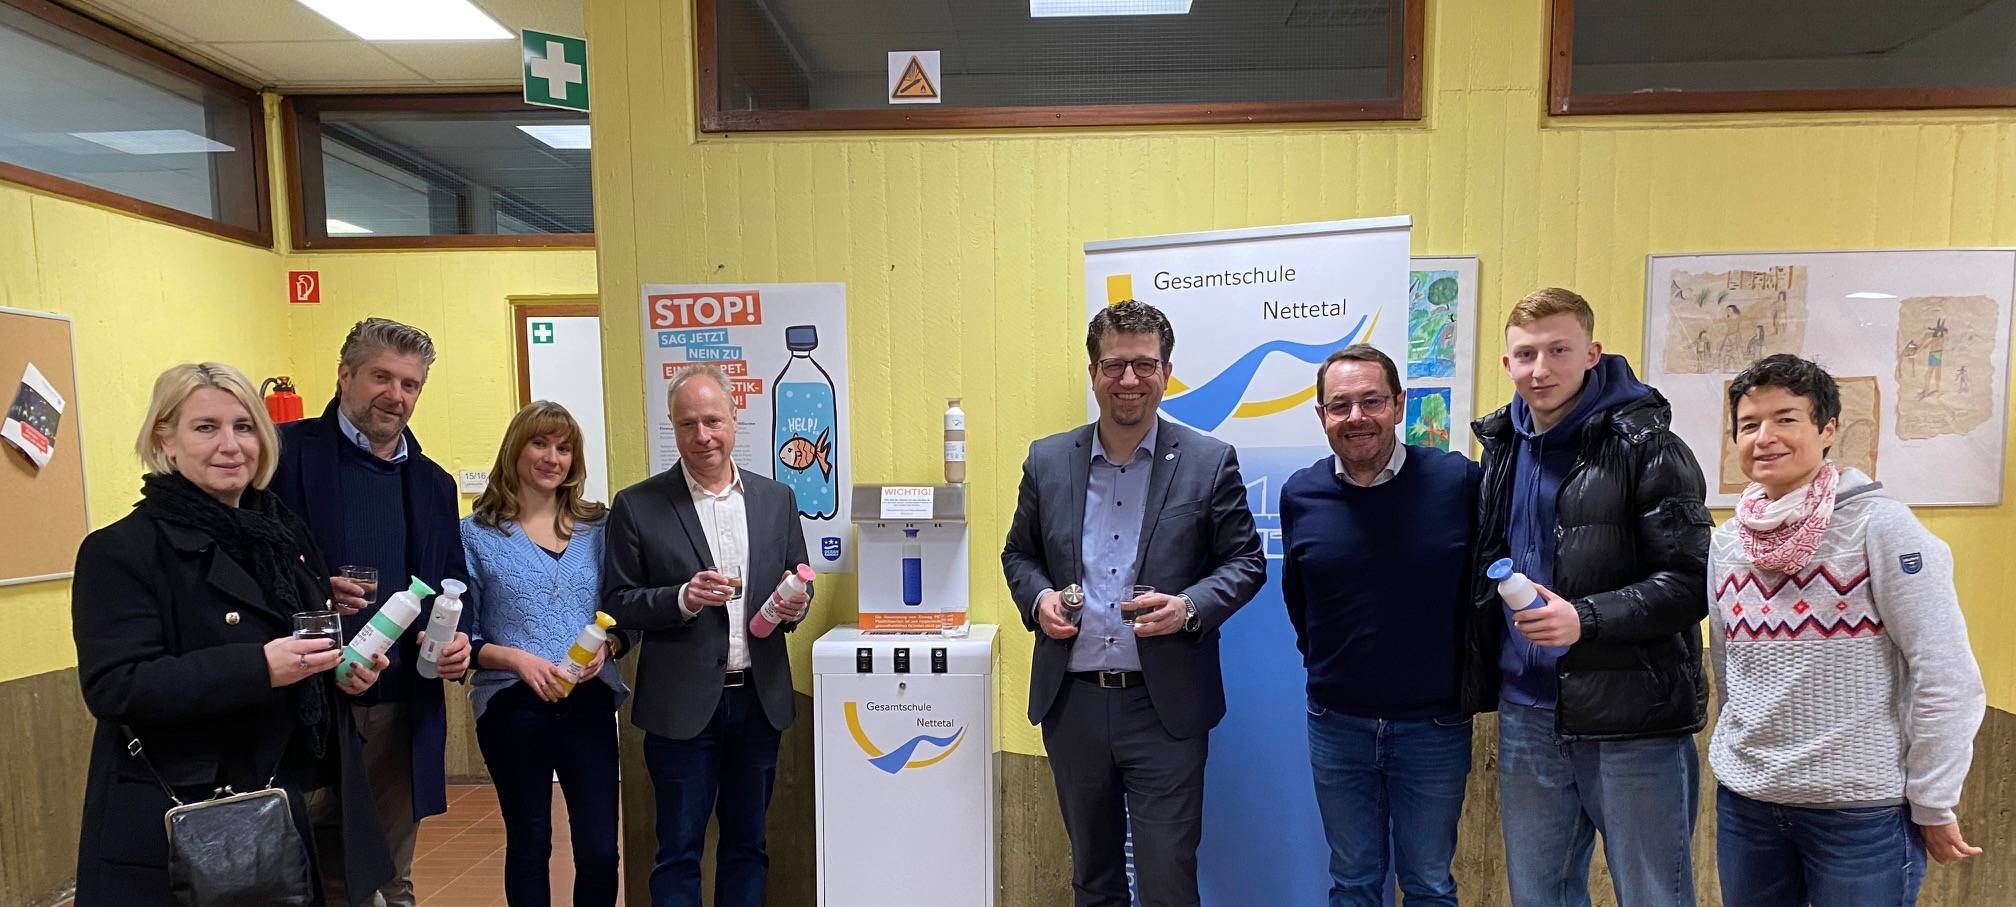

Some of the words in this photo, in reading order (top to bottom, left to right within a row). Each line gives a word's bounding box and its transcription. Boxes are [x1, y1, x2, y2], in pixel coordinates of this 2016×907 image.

[1154, 265, 1296, 291] Gesamtschule
[654, 295, 756, 327] STOP!
[1263, 298, 1347, 320] Nettetal
[661, 333, 687, 345] SAG
[689, 331, 726, 344] JETZT
[688, 348, 720, 360] NEIN
[722, 349, 740, 360] ZU
[788, 417, 818, 434] HELP!
[884, 488, 931, 497] WICHTIG!
[866, 701, 932, 712] Gesamtschule
[916, 718, 954, 728] Nettetal
